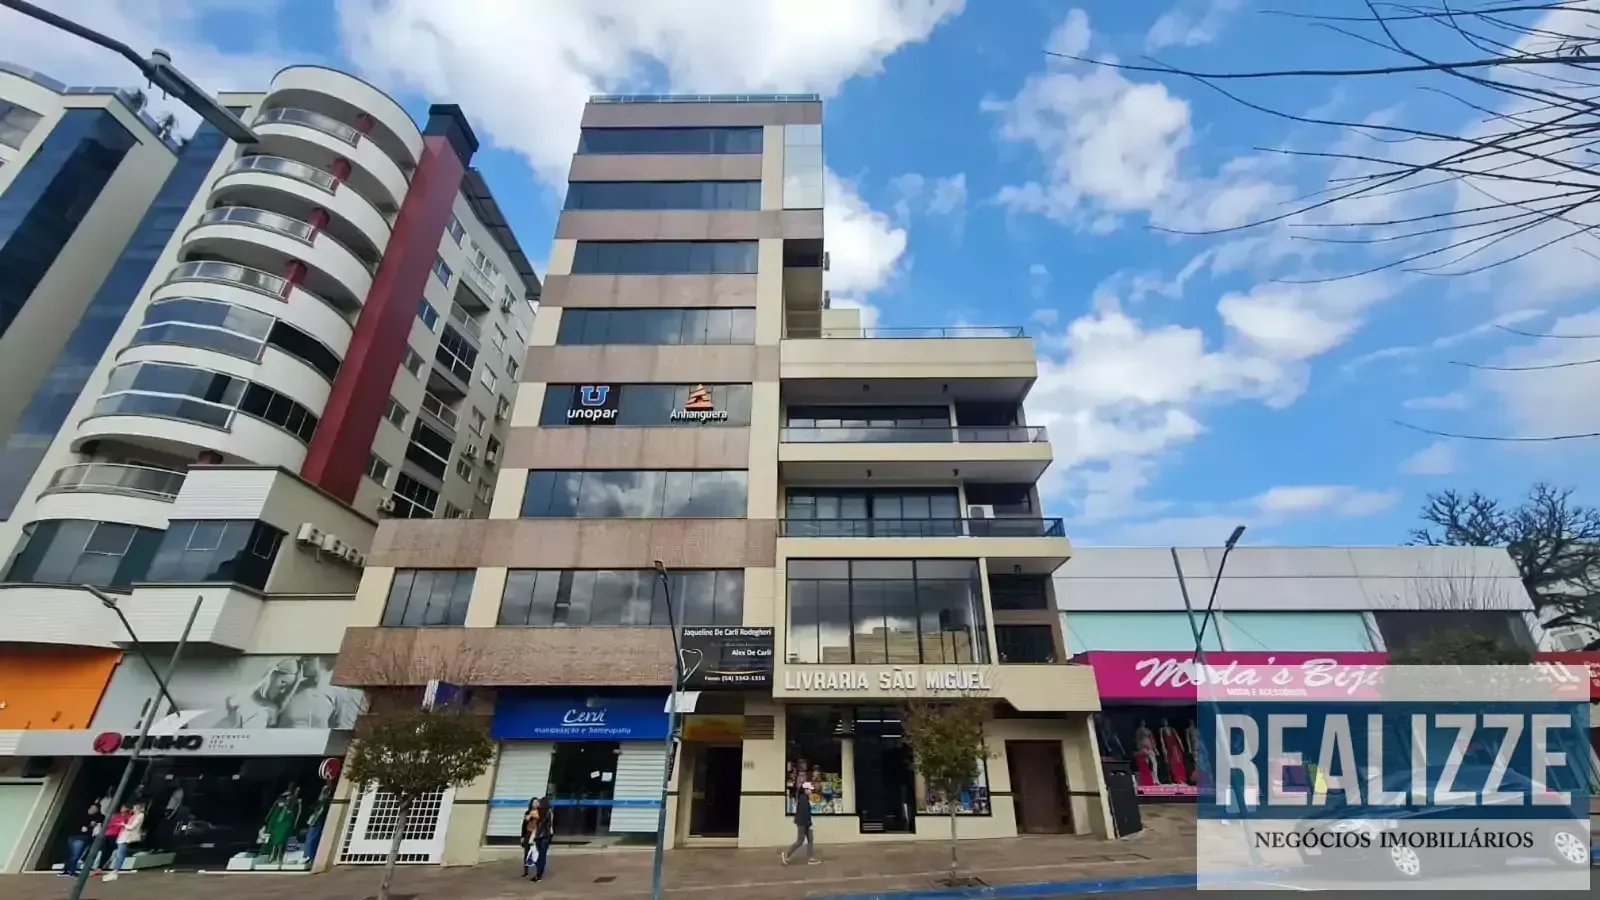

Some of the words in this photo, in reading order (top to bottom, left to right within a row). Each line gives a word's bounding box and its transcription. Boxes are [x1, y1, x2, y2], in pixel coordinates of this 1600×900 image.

[567, 408, 618, 421] unopar
[670, 408, 728, 421] Anhanguera
[684, 629, 713, 638] Jaqueline
[732, 648, 746, 656] Alex
[747, 648, 756, 656] De
[784, 669, 869, 692] LIVRARIA
[878, 665, 916, 690] SÃO
[926, 670, 991, 692] MIGUEL
[563, 708, 607, 723] Cervi
